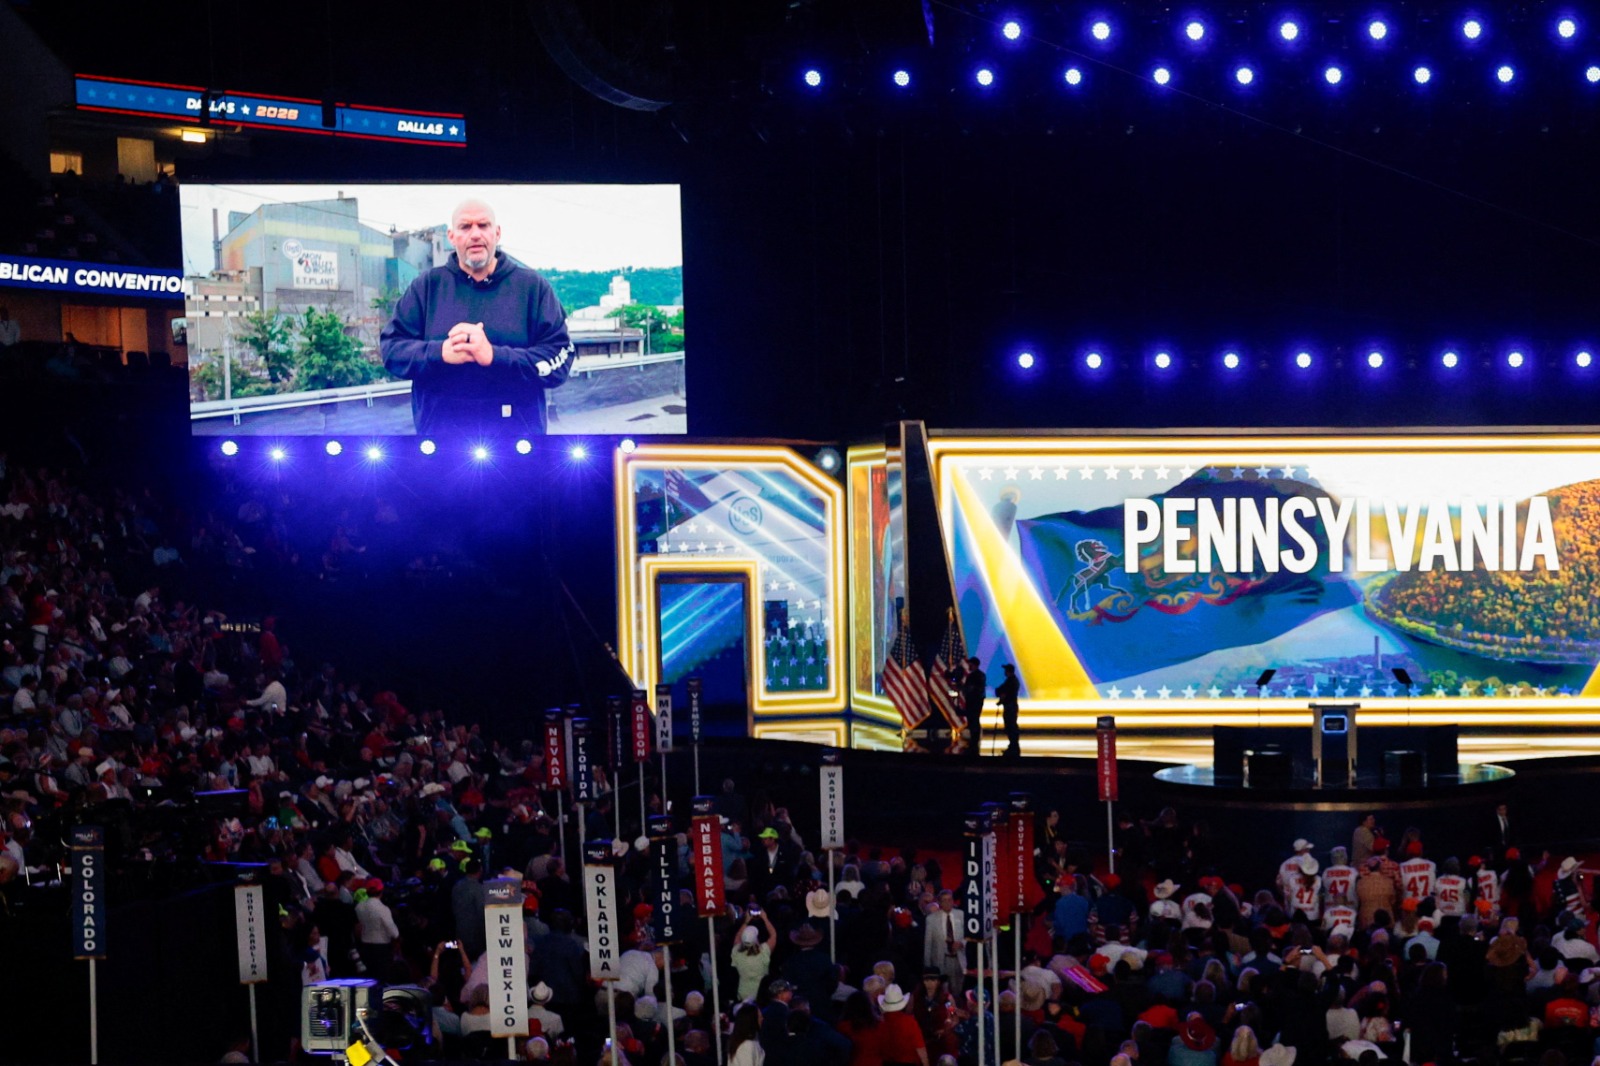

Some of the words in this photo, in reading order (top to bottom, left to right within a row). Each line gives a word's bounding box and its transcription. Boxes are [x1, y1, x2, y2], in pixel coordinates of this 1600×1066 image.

[397, 120, 444, 135] DALLAS
[0, 262, 69, 284] BLICAN
[1123, 496, 1561, 574] PENNSYLVANIA
[634, 704, 646, 757] OREGON
[659, 700, 669, 748] MAINE
[691, 692, 700, 742] VERMONT
[548, 727, 561, 786] NEVADA
[578, 737, 588, 799] FLORIDA
[827, 772, 837, 842] WASHINGTON
[660, 844, 673, 937] ILLINOIS
[700, 822, 716, 910] NEBRASKA
[967, 841, 980, 934] IDAHO
[1328, 880, 1350, 895] 47
[1402, 863, 1430, 873] TRUMP
[1407, 875, 1429, 897] 47
[81, 854, 96, 952] COLORADO
[246, 892, 254, 922] NORTH
[1296, 888, 1314, 904] 47
[1440, 888, 1459, 902] 45
[498, 914, 513, 948] NEW
[595, 873, 611, 971] OKLAHOMA
[248, 926, 257, 976] CAROLINA
[500, 956, 516, 1027] MEXICO
